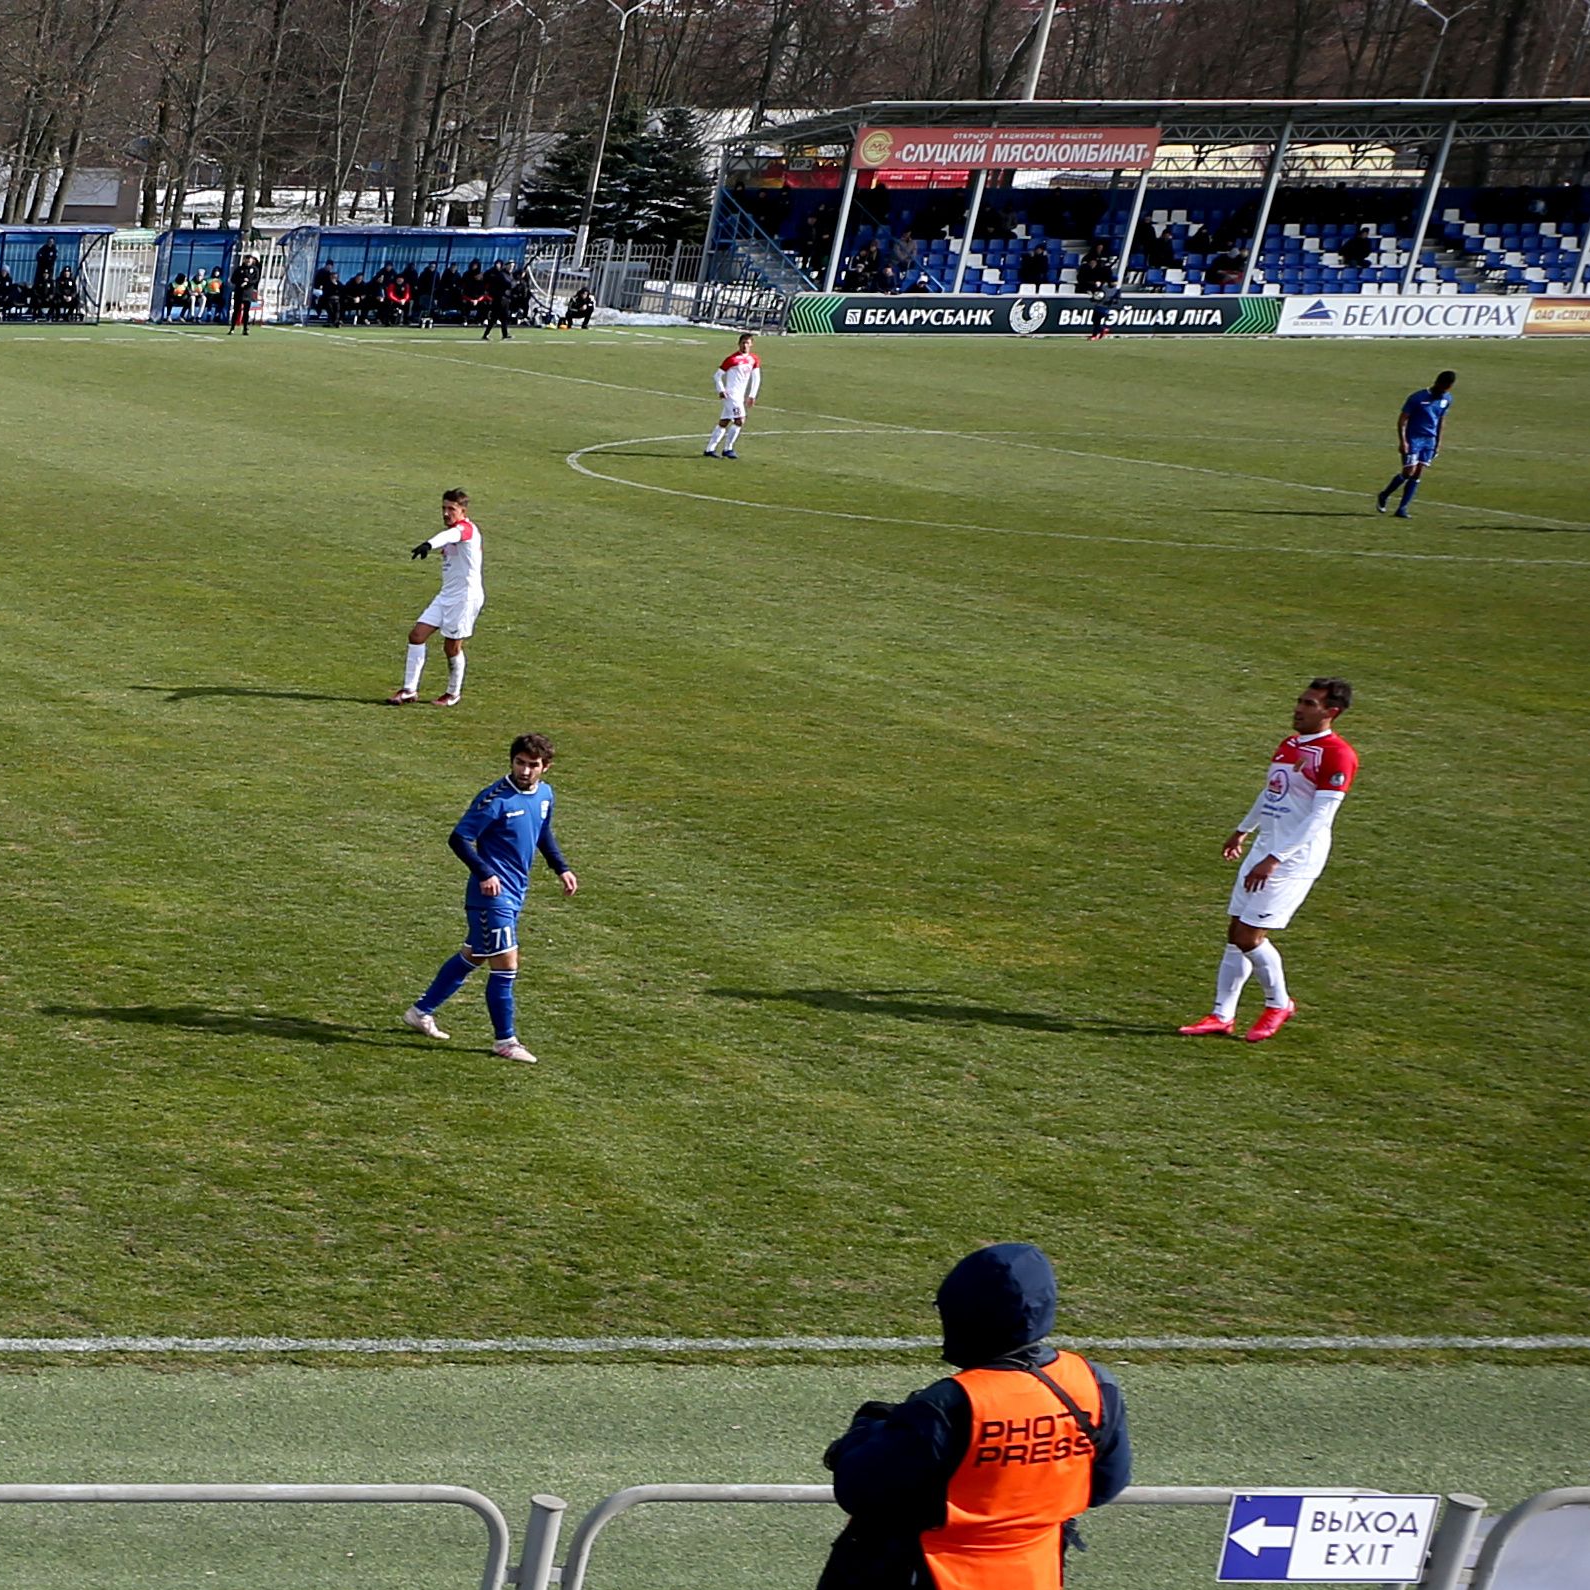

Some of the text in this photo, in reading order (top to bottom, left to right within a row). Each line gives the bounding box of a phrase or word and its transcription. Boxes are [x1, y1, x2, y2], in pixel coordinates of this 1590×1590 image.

[895, 140, 1150, 164] «СЛУЦКИЙ МЯСОКОМБИНАТ»
[864, 307, 994, 326] БЕЛАРУСБАНК
[1342, 304, 1522, 326] БЕЛГОССТРАХ
[491, 926, 512, 949] 71
[973, 1436, 1093, 1468] PRESS
[1310, 1511, 1420, 1539] ВЫХОД
[1323, 1543, 1395, 1567] EXIT
